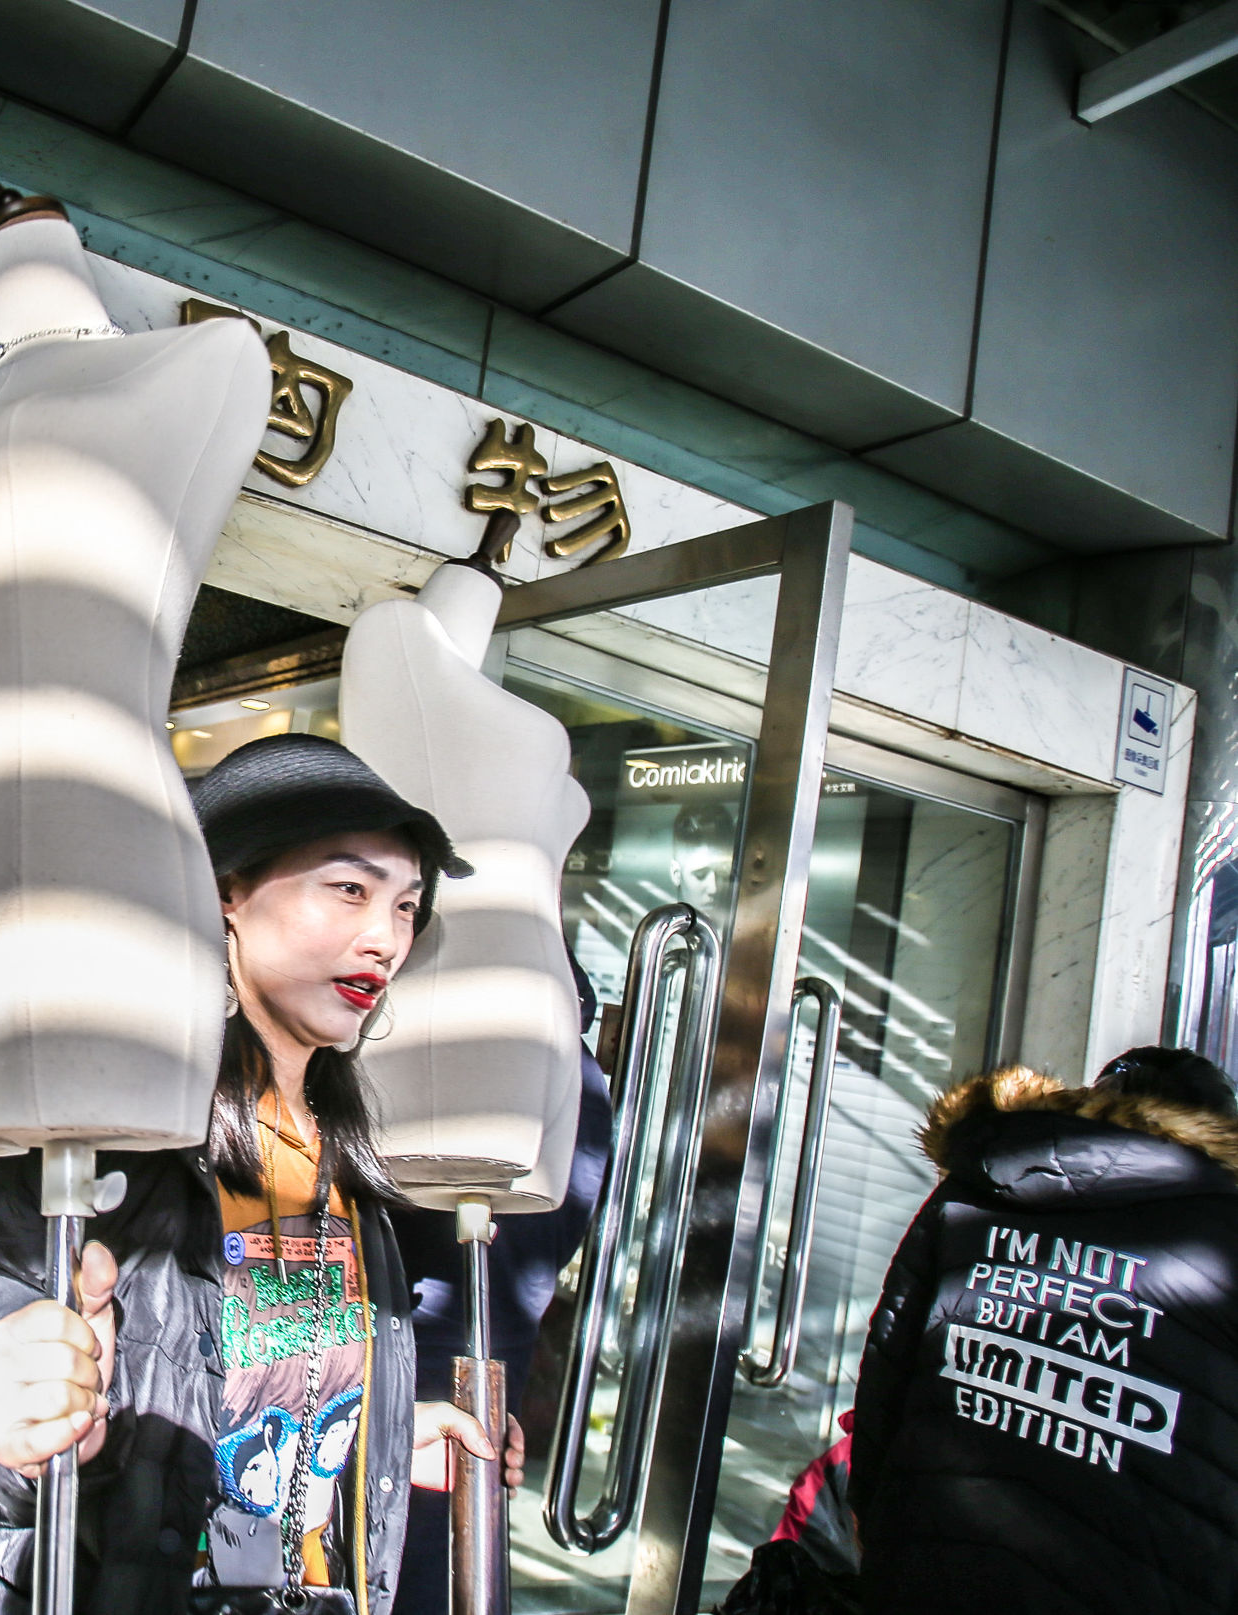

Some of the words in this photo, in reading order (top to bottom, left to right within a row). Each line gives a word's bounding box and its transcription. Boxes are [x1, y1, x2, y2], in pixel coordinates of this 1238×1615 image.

[987, 1227, 1040, 1266] I'M
[1049, 1238, 1147, 1292] NOT
[966, 1263, 1164, 1338] PERFECT
[976, 1297, 1036, 1334] BUT
[1039, 1313, 1051, 1340] I
[1057, 1323, 1129, 1367] AM
[956, 1387, 1124, 1473] EDITION
